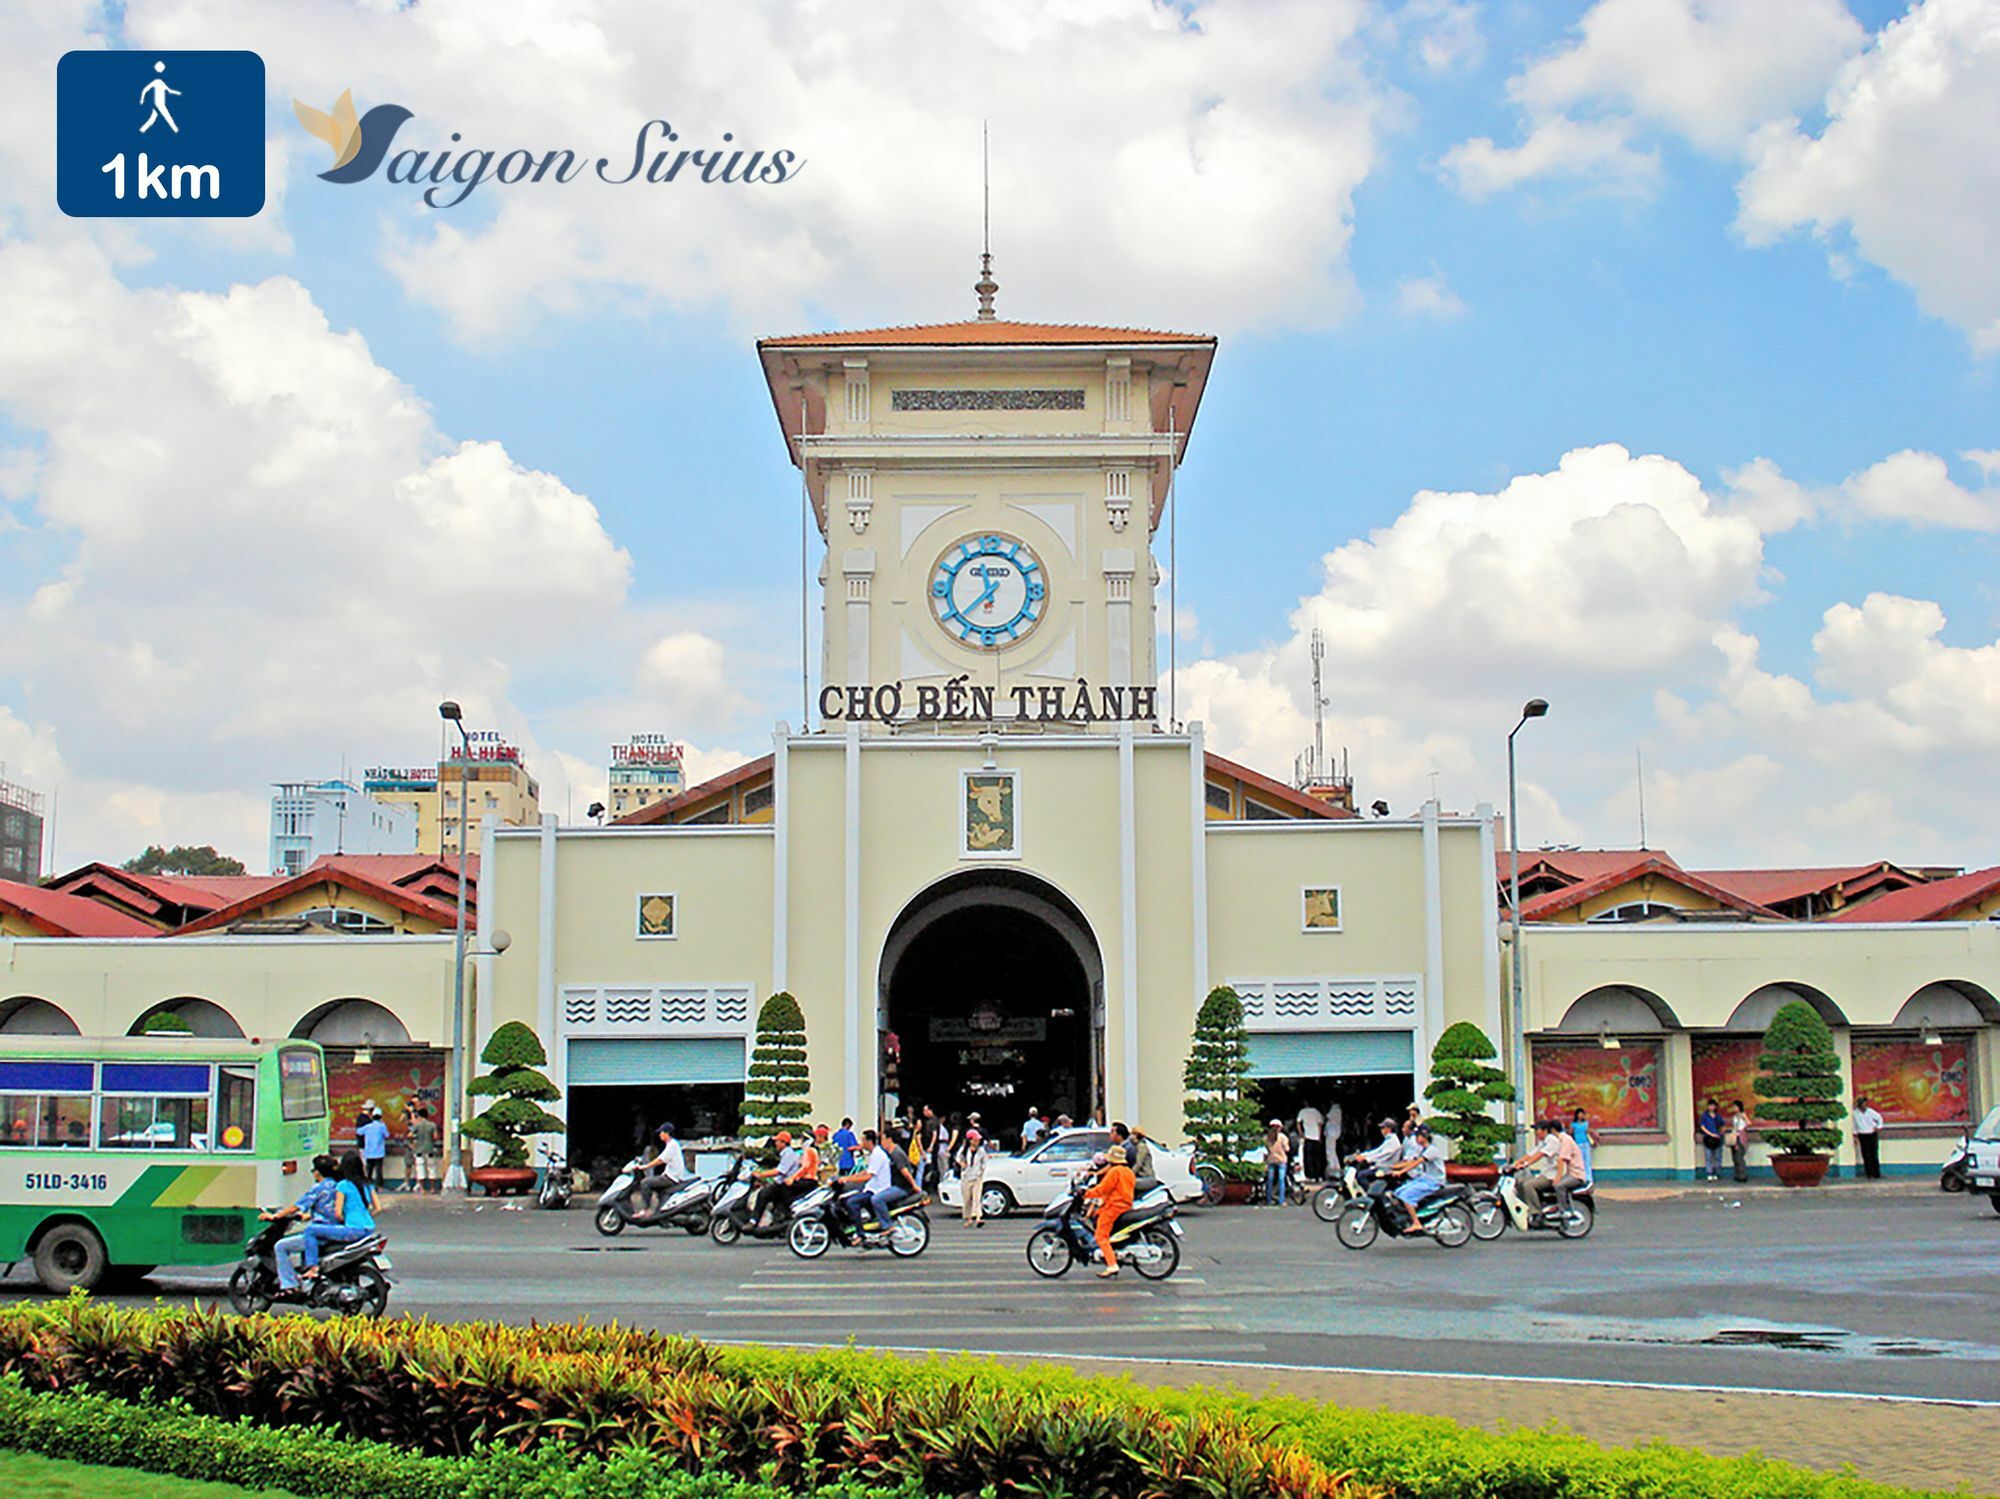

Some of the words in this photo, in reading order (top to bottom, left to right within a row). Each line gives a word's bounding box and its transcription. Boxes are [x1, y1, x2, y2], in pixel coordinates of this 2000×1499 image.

[977, 536, 1002, 554] 12
[969, 567, 1010, 577] SIKO
[932, 580, 948, 598] 9
[981, 629, 996, 646] 6
[819, 681, 902, 726] CHỢ
[917, 674, 995, 721] BẾN
[1010, 677, 1157, 721] THÀNH
[631, 734, 666, 744] HOTEL
[26, 1173, 107, 1190] 51LD-3416
